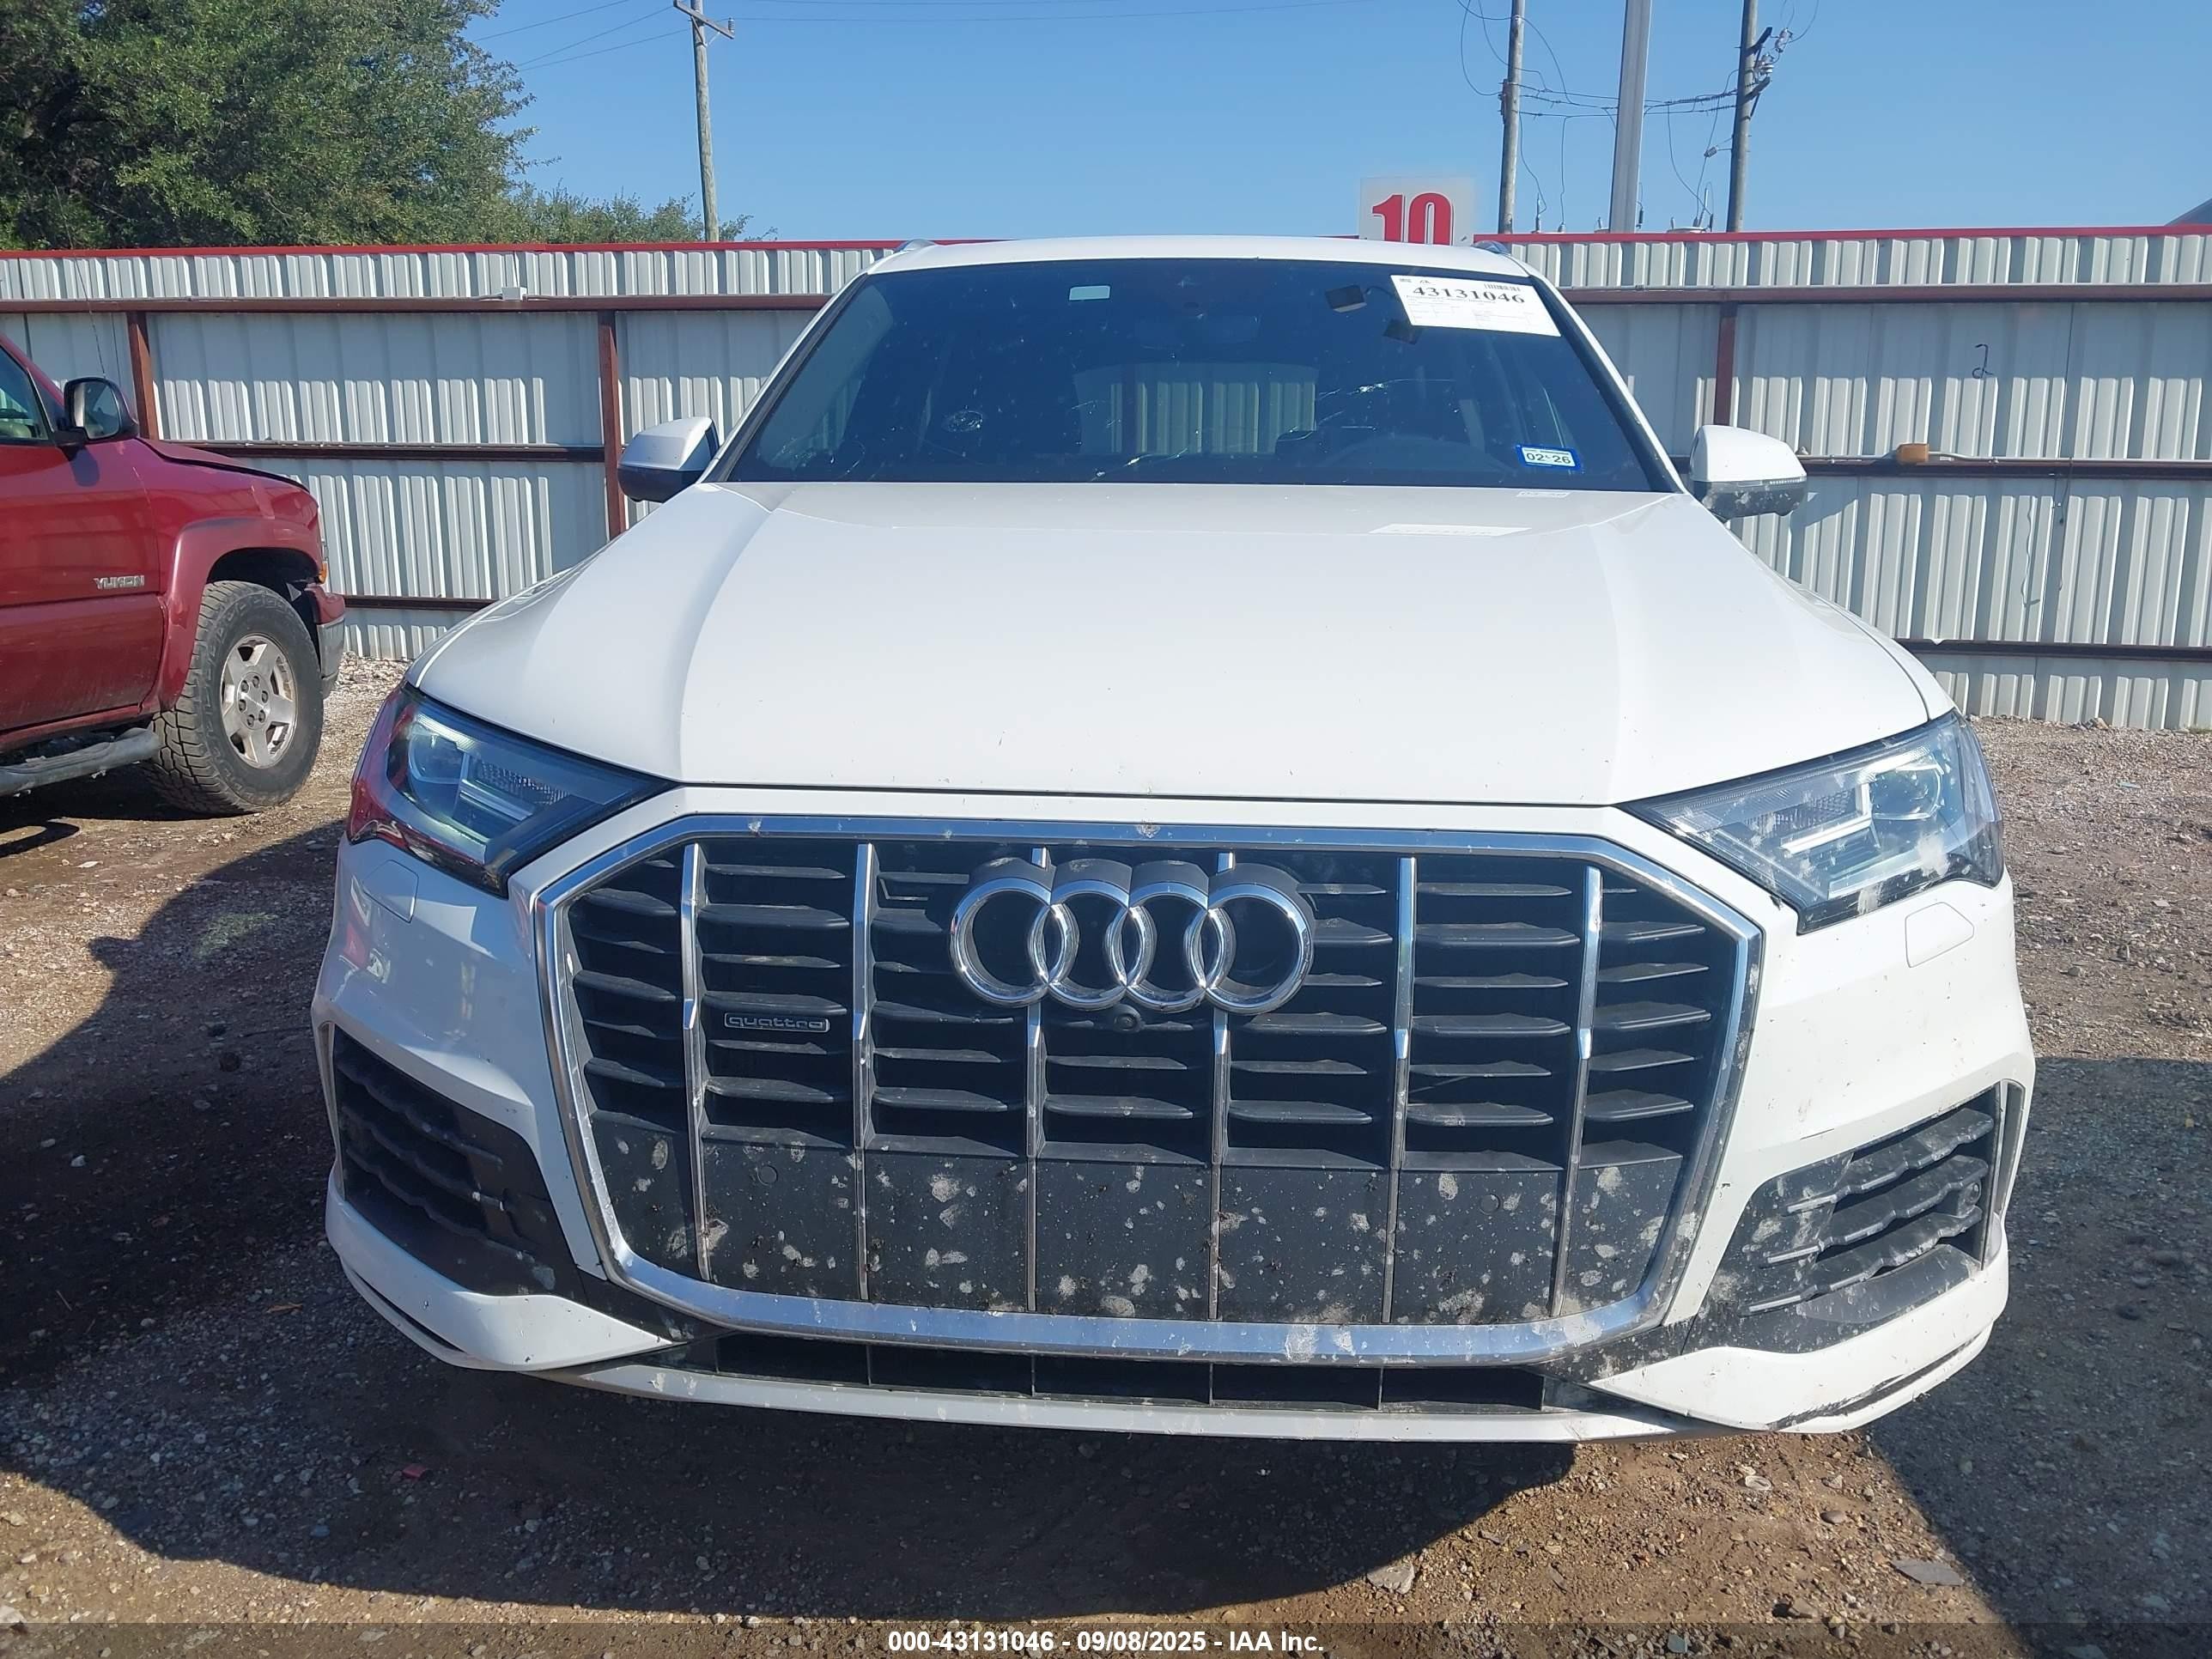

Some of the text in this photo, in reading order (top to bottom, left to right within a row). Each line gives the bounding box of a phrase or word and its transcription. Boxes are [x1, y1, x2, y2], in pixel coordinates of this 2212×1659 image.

[1371, 191, 1453, 246] 10
[1413, 286, 1525, 304] 43131046
[729, 1017, 823, 1029] quattro
